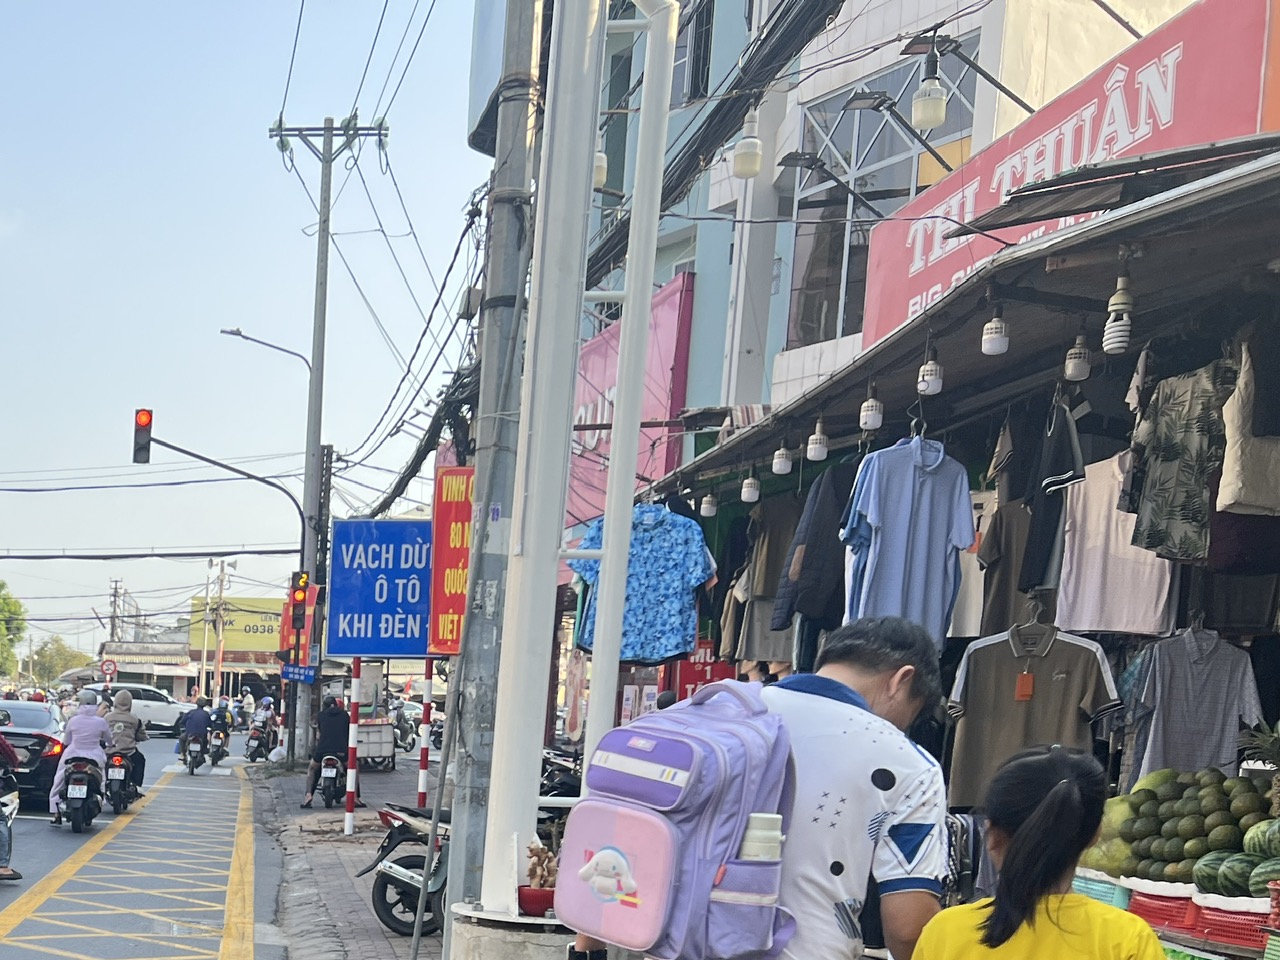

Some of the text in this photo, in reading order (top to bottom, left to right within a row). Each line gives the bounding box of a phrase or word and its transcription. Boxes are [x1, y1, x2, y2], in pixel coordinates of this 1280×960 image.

[442, 475, 467, 502] VINH
[450, 522, 463, 549] 80
[341, 538, 432, 574] VẠCH DỪ
[375, 574, 420, 603] Ô TÔ
[244, 625, 274, 634] 0938
[338, 608, 420, 638] KHI ĐÈN
[439, 609, 459, 646] VIỆT
[704, 666, 711, 680] 1
